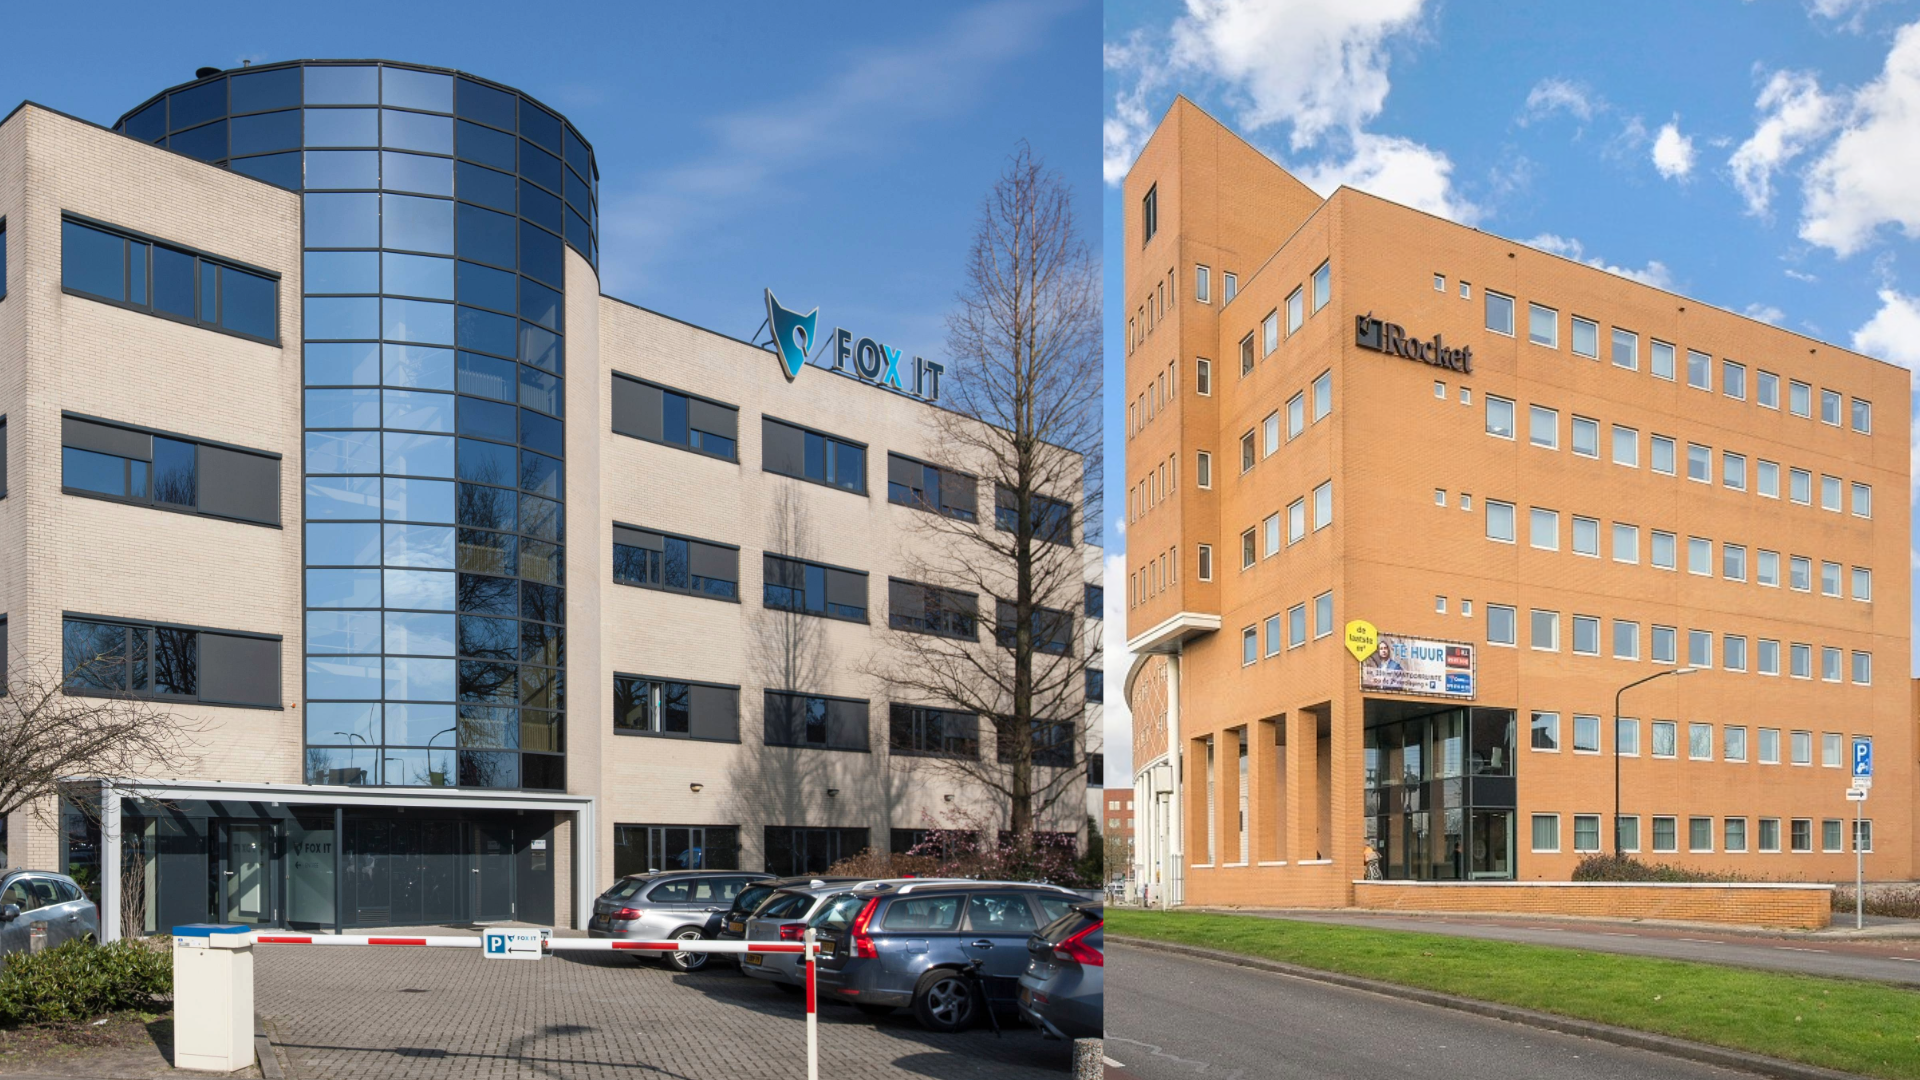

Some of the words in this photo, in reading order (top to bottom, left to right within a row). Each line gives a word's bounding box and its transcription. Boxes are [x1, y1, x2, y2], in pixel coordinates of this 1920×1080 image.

[1385, 323, 1473, 373] Rocket
[833, 326, 903, 389] FOX
[912, 355, 945, 400] IT
[1393, 643, 1407, 658] TE
[1411, 646, 1444, 662] HUUR
[1857, 744, 1868, 762] P
[305, 843, 321, 853] FOX
[323, 843, 331, 853] IT
[491, 936, 502, 952] P
